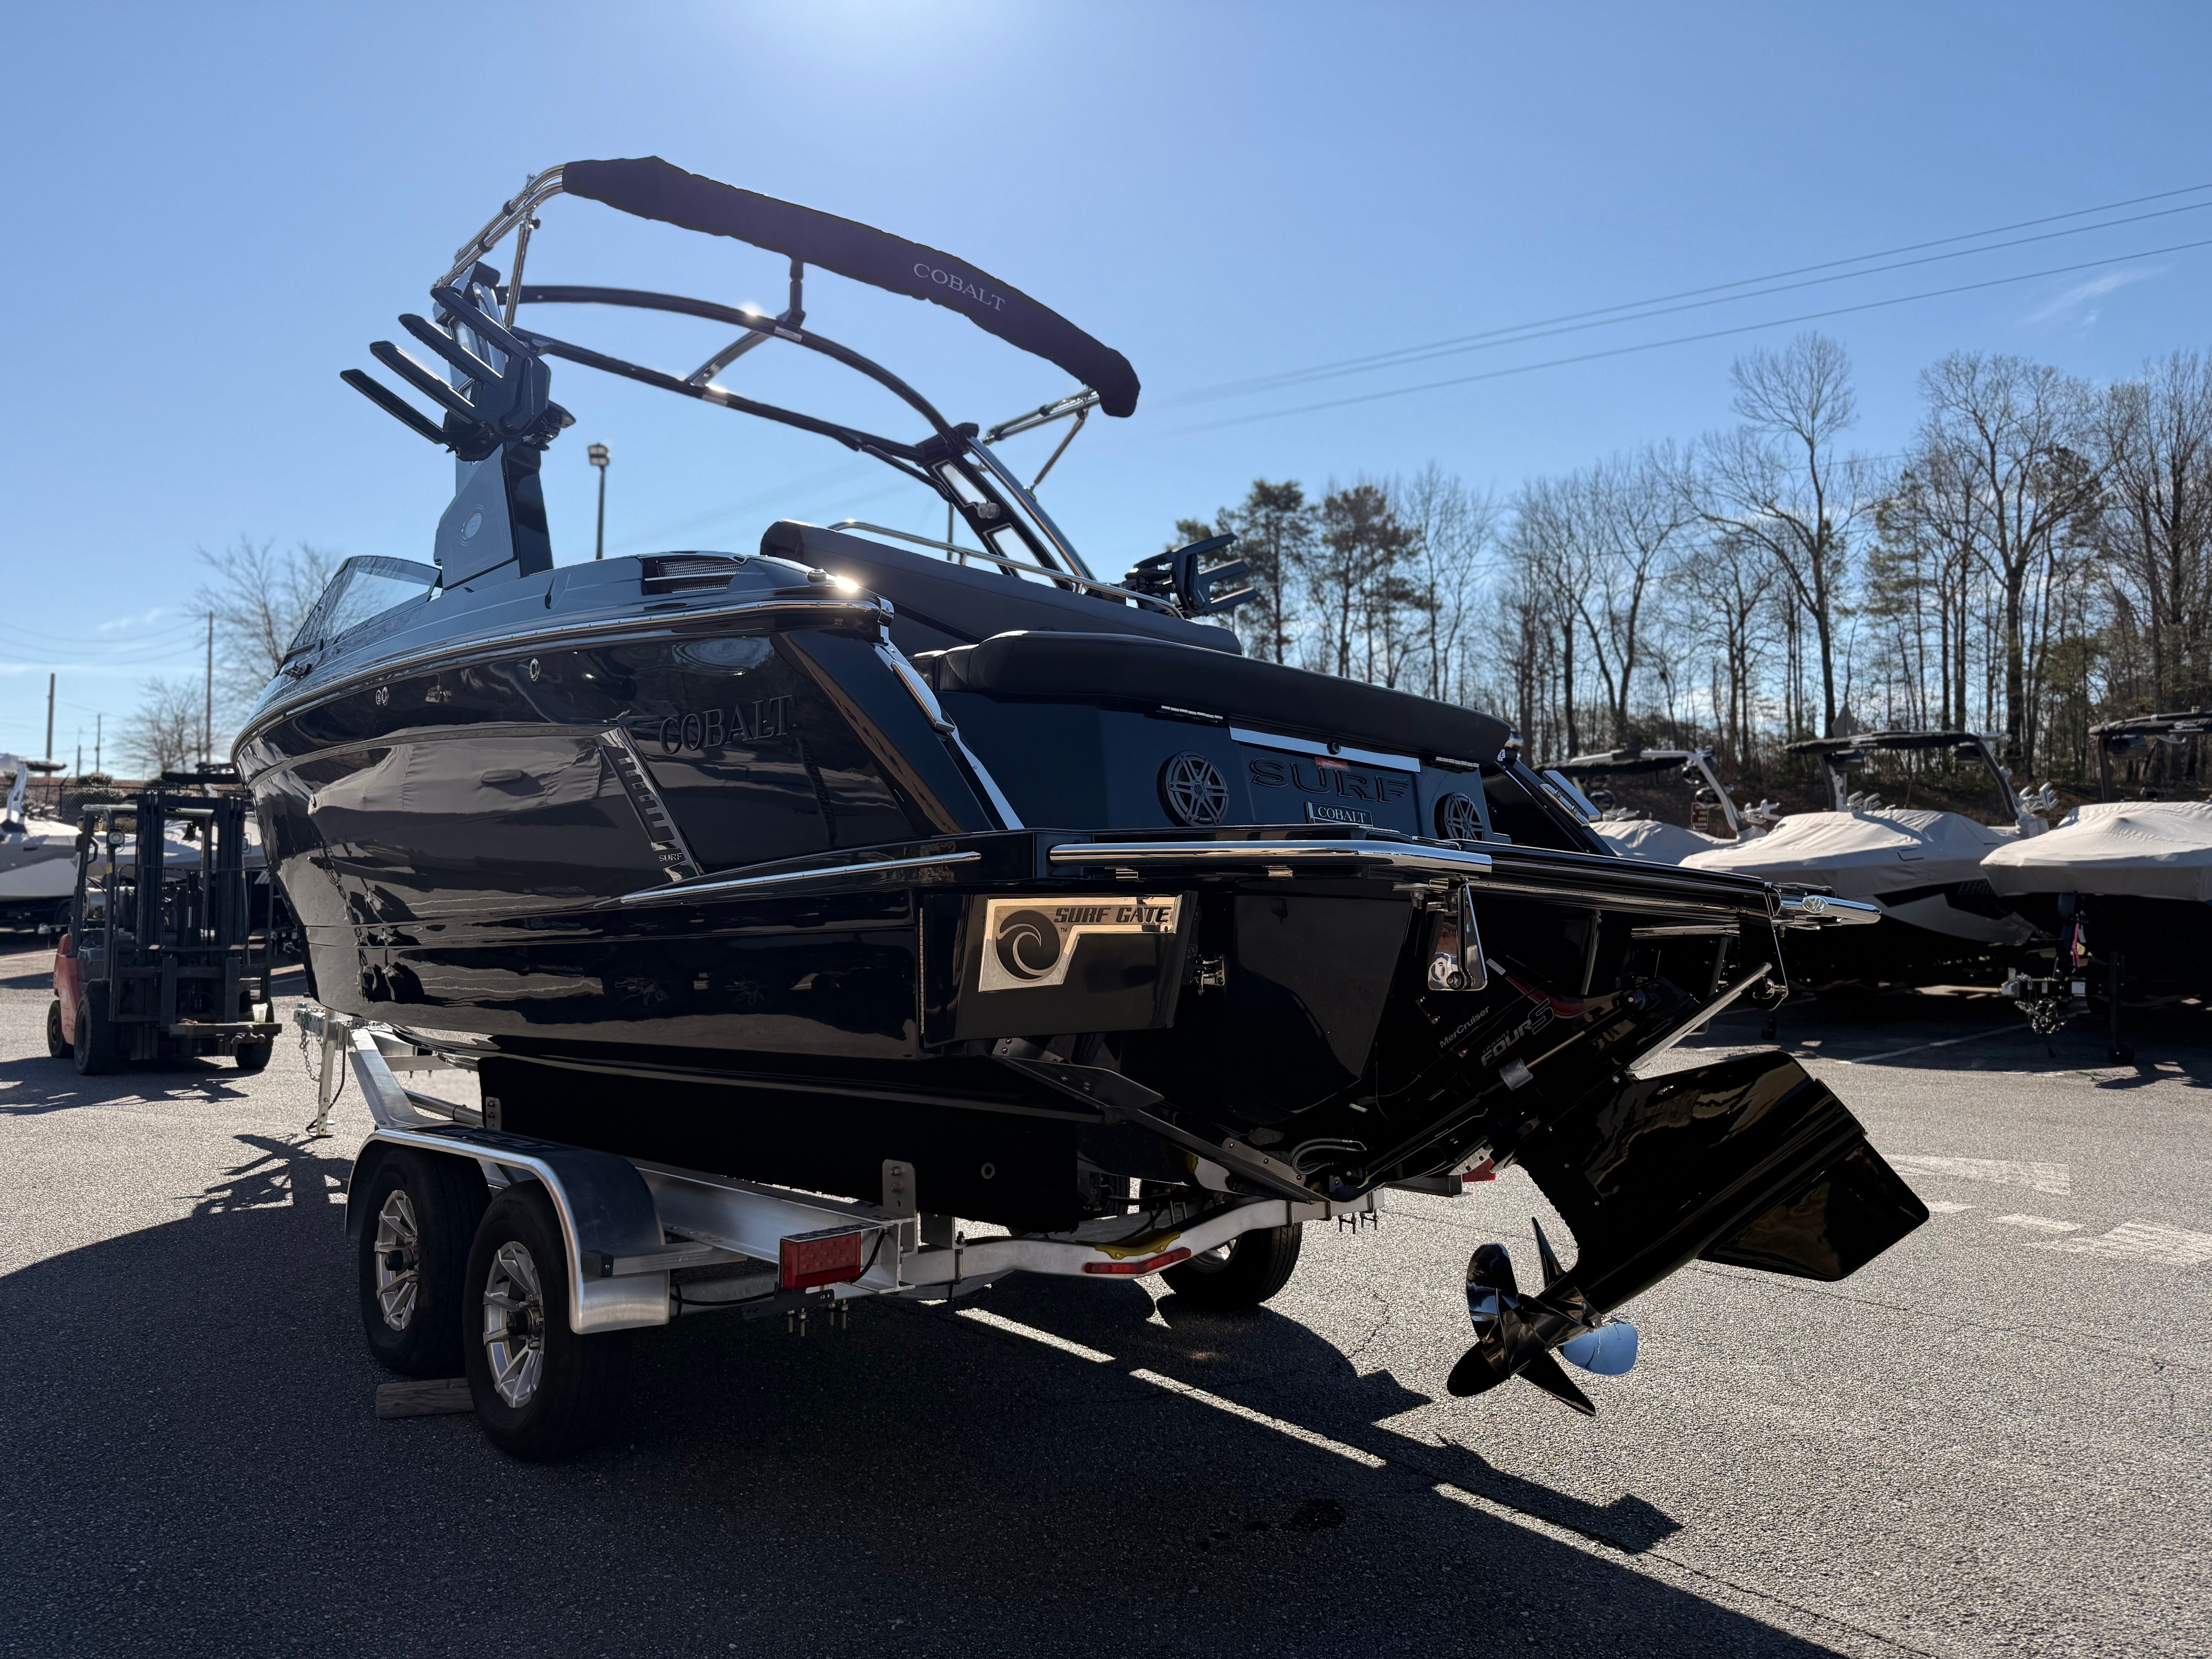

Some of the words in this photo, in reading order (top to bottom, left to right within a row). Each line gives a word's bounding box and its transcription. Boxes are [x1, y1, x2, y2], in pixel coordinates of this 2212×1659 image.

[913, 263, 1005, 311] COBALT
[659, 694, 796, 754] COBALT
[1249, 758, 1410, 804] SURF
[1317, 806, 1366, 823] COBALT
[659, 852, 683, 862] SURF
[1054, 907, 1111, 923] SURF
[1116, 907, 1172, 923] GATE
[1439, 1006, 1489, 1048] MerCruiser
